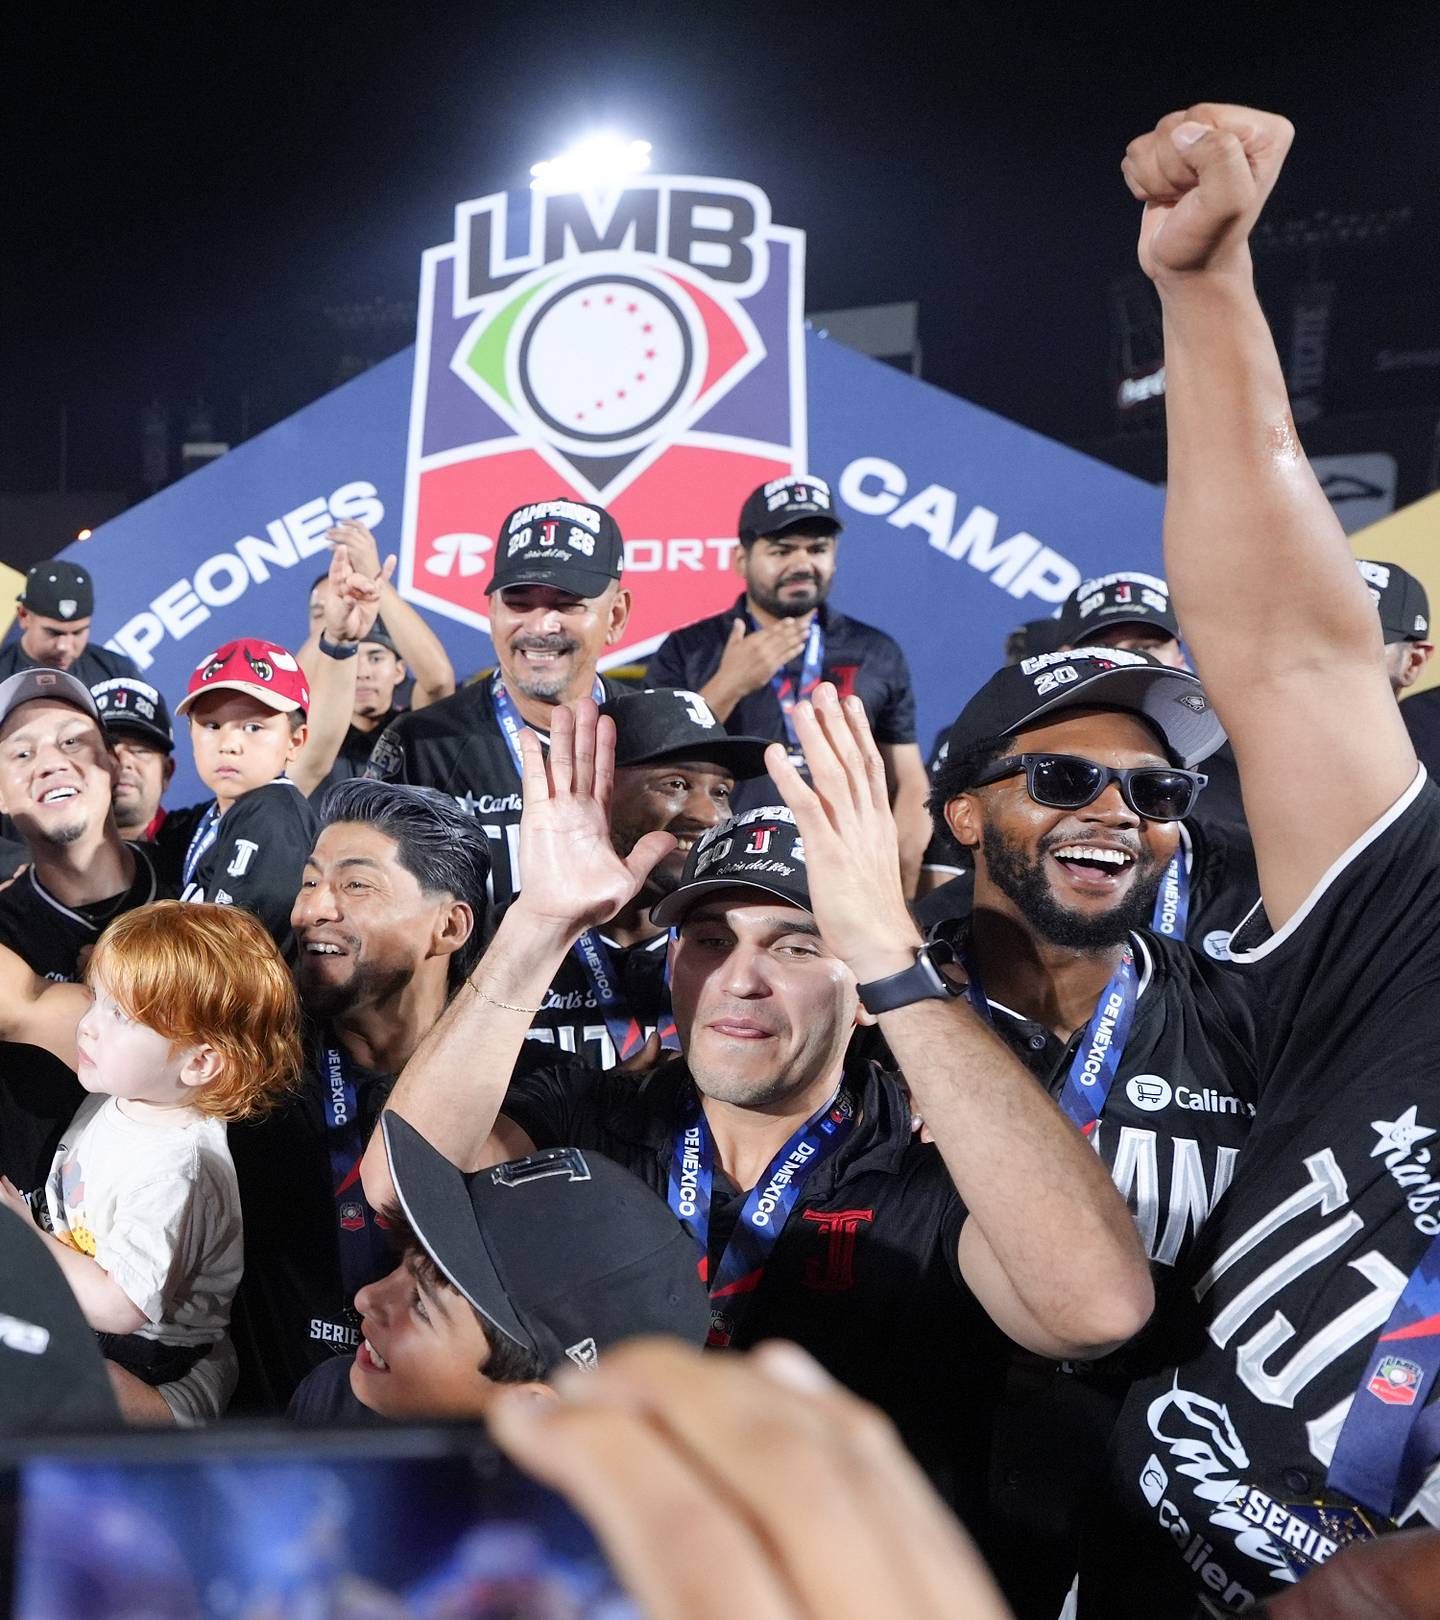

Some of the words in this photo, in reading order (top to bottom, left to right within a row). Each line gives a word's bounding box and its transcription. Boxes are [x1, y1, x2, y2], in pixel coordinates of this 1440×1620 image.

[468, 180, 757, 300] LMB
[1034, 664, 1080, 696] 20
[696, 805, 797, 853] CAMPE
[1103, 992, 1123, 1019] DE
[1080, 1016, 1117, 1087] MÉXICO
[684, 1127, 700, 1148] DE
[788, 1141, 816, 1167] DE
[679, 1146, 701, 1217] MÉXICO
[751, 1156, 800, 1227] MÉXICO
[310, 1318, 361, 1347] SERIE
